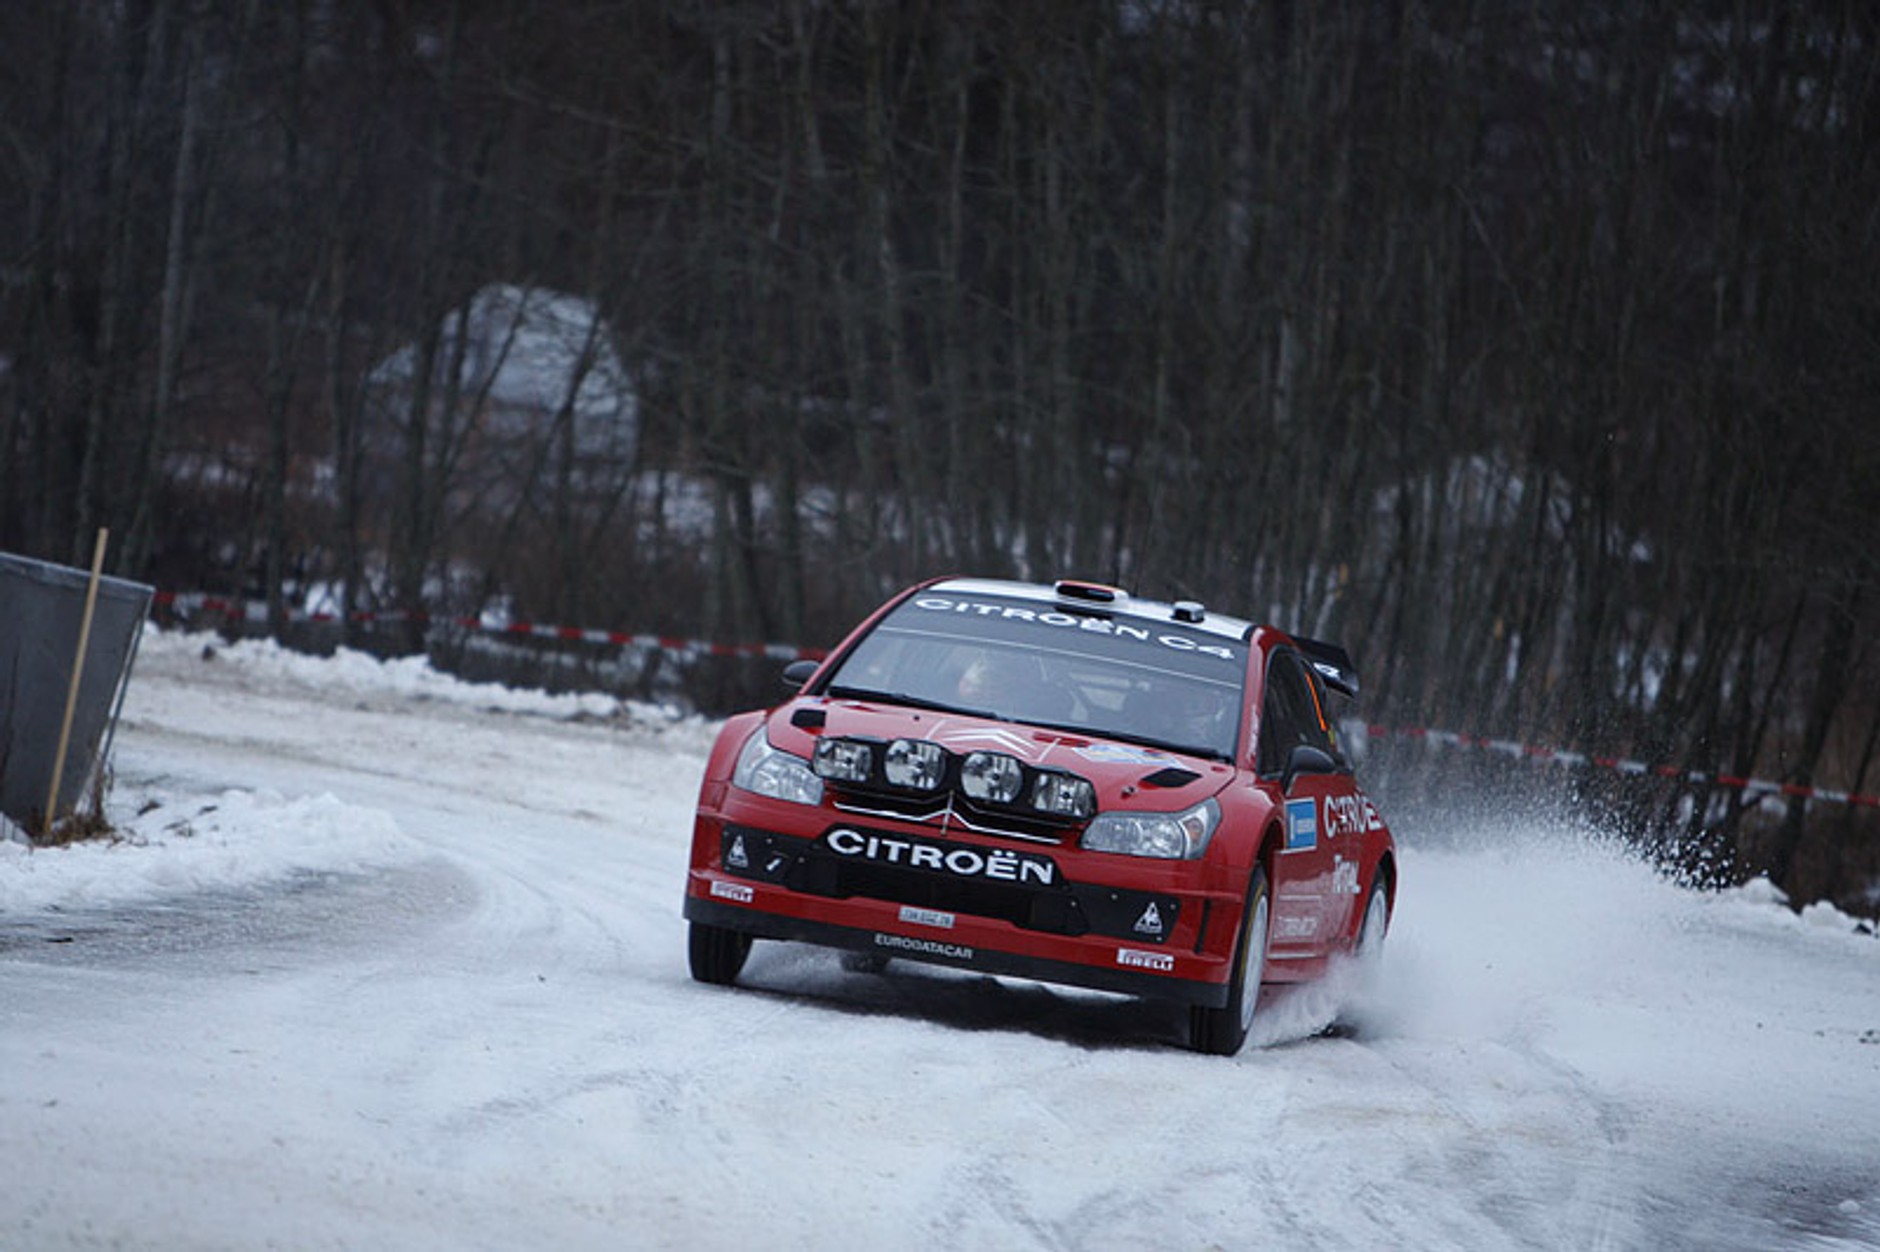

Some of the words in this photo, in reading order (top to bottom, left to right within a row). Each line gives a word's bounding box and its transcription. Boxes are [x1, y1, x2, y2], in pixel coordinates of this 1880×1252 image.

[1158, 635, 1235, 659] C4
[826, 828, 1054, 884] CITROËN
[874, 933, 973, 959] EURODATACAR
[1119, 949, 1173, 971] PIRELLI
